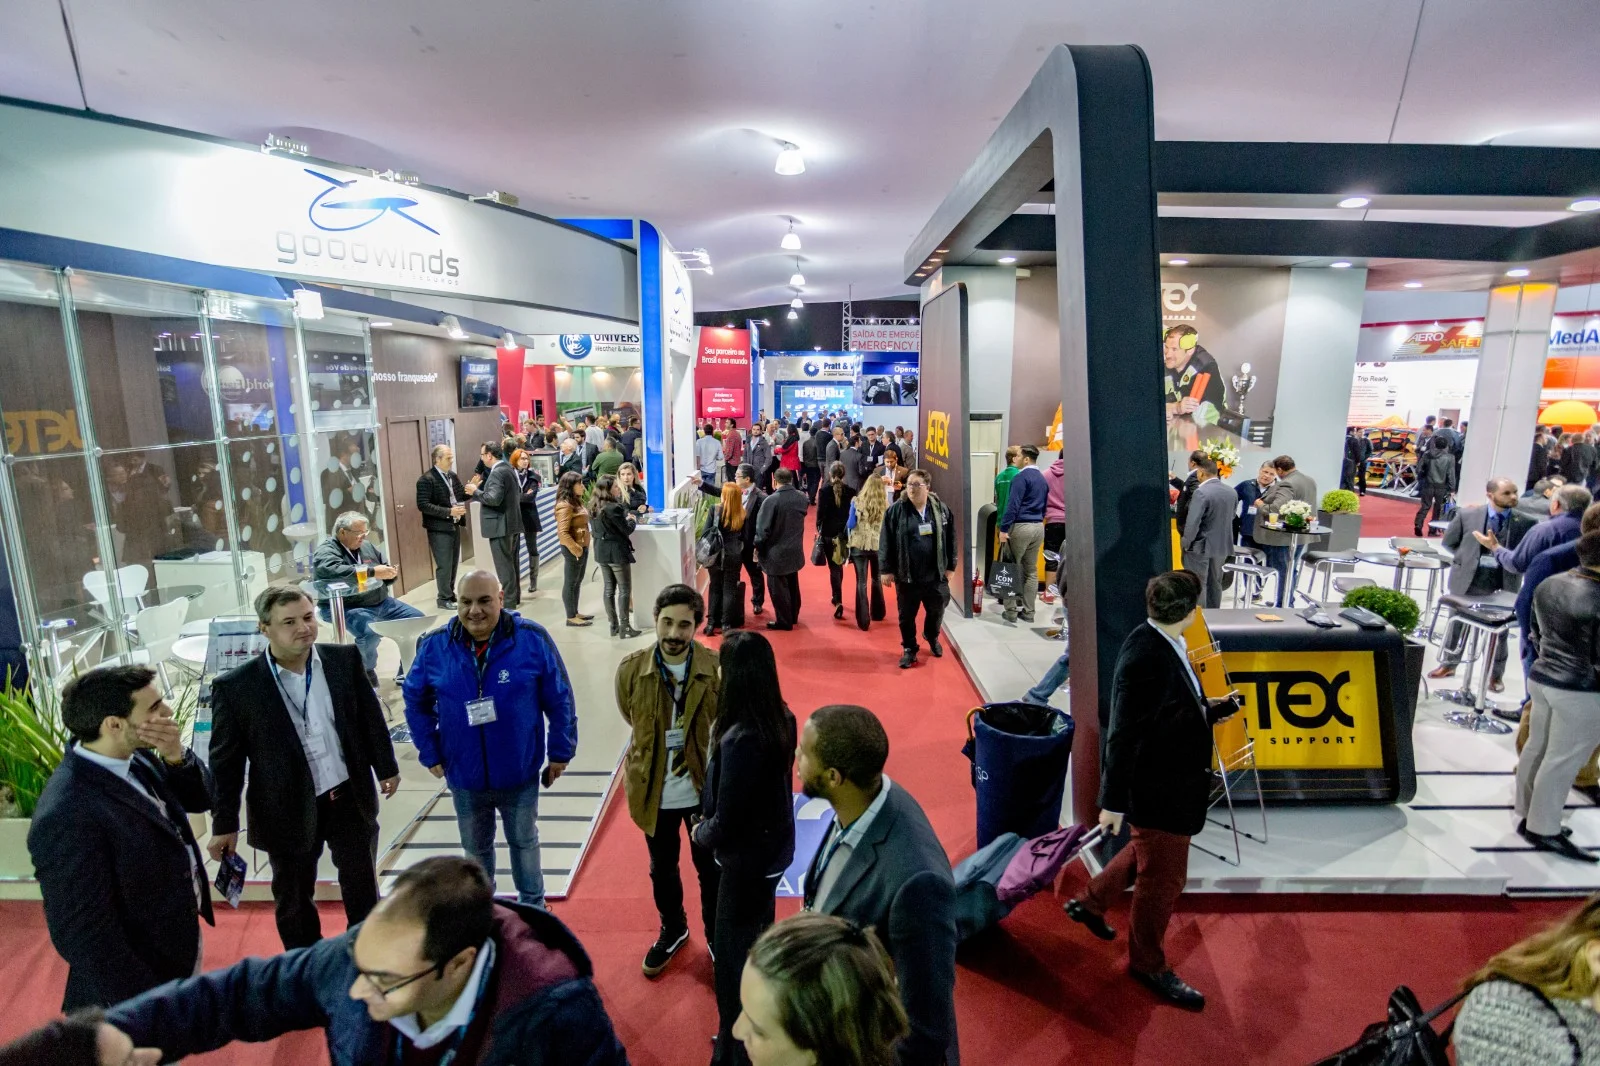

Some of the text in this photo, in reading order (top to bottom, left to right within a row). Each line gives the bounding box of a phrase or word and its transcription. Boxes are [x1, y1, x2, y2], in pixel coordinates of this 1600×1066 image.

[852, 330, 875, 338] SAÍDA
[1404, 332, 1445, 343] AERO
[704, 346, 715, 354] Seu
[702, 356, 717, 364] Brasil
[824, 362, 841, 370] Pratt
[842, 362, 848, 370] &
[925, 410, 951, 459] JETEX
[995, 574, 1013, 583] ICON
[1270, 736, 1356, 745] SUPPORT
